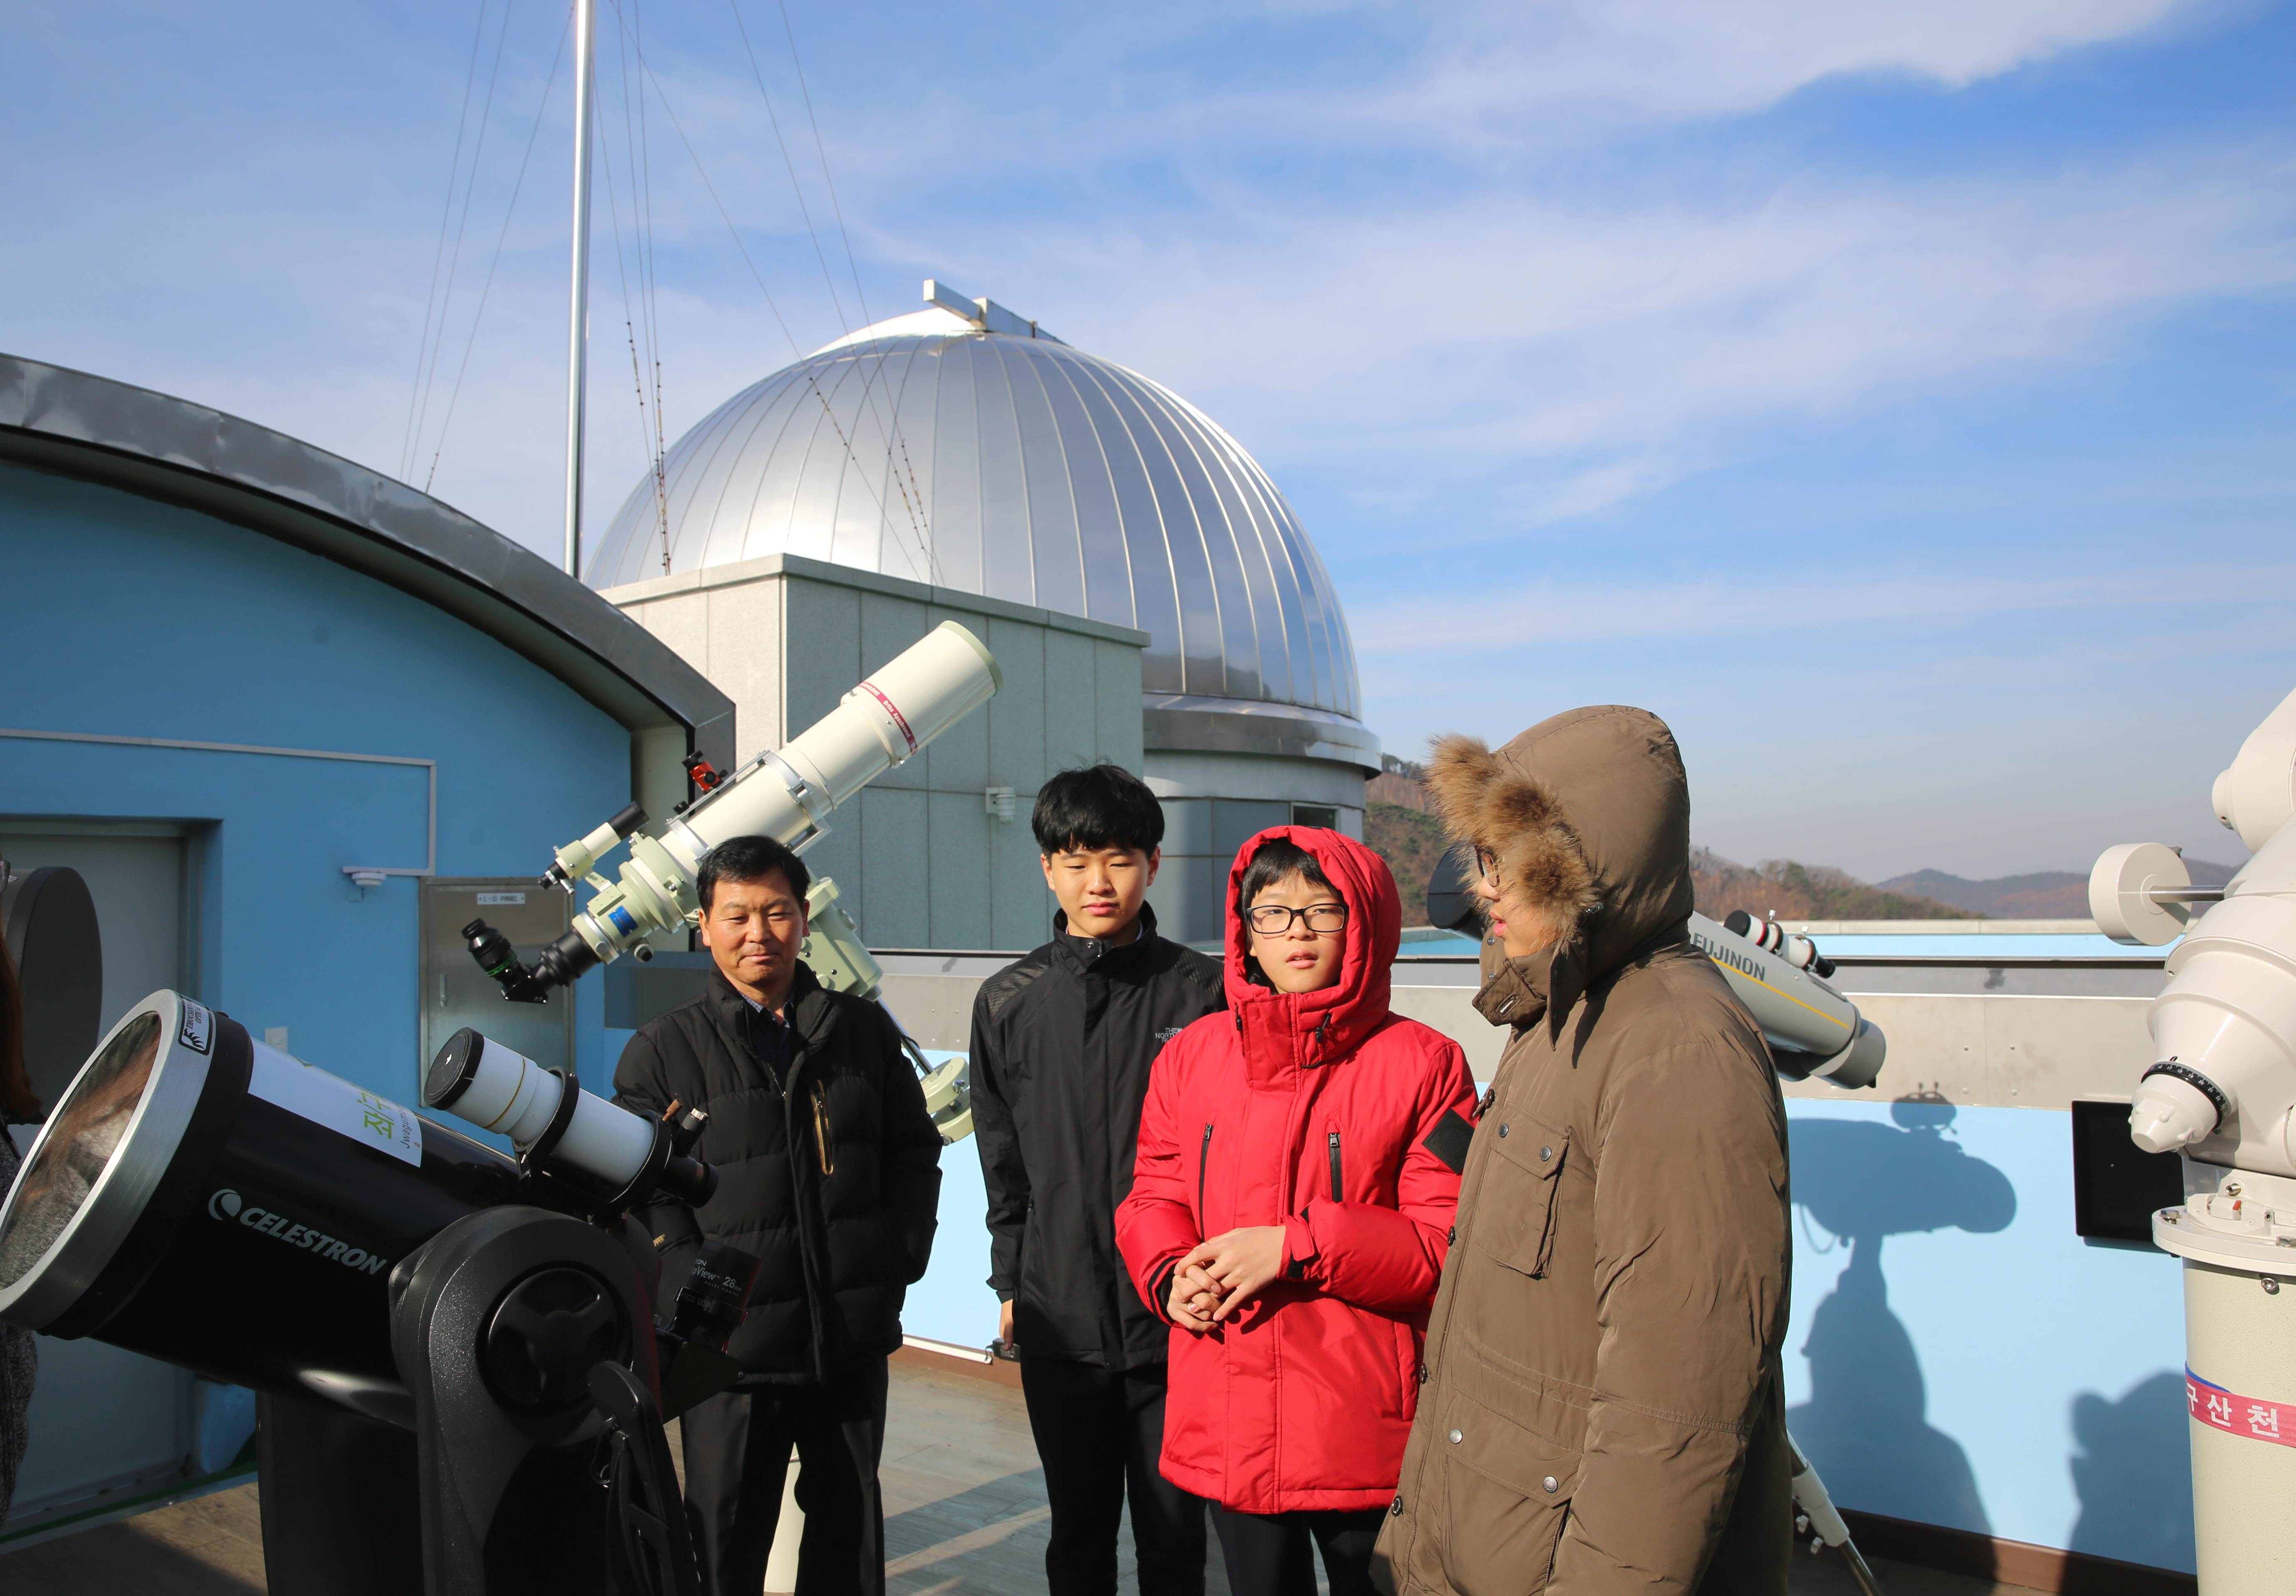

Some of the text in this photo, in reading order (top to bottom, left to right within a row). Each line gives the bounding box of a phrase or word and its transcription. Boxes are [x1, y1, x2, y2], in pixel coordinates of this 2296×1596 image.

[1693, 932, 1765, 982] FUJINON
[357, 1091, 395, 1139] 좌구
[240, 1207, 388, 1275] CELESTRON
